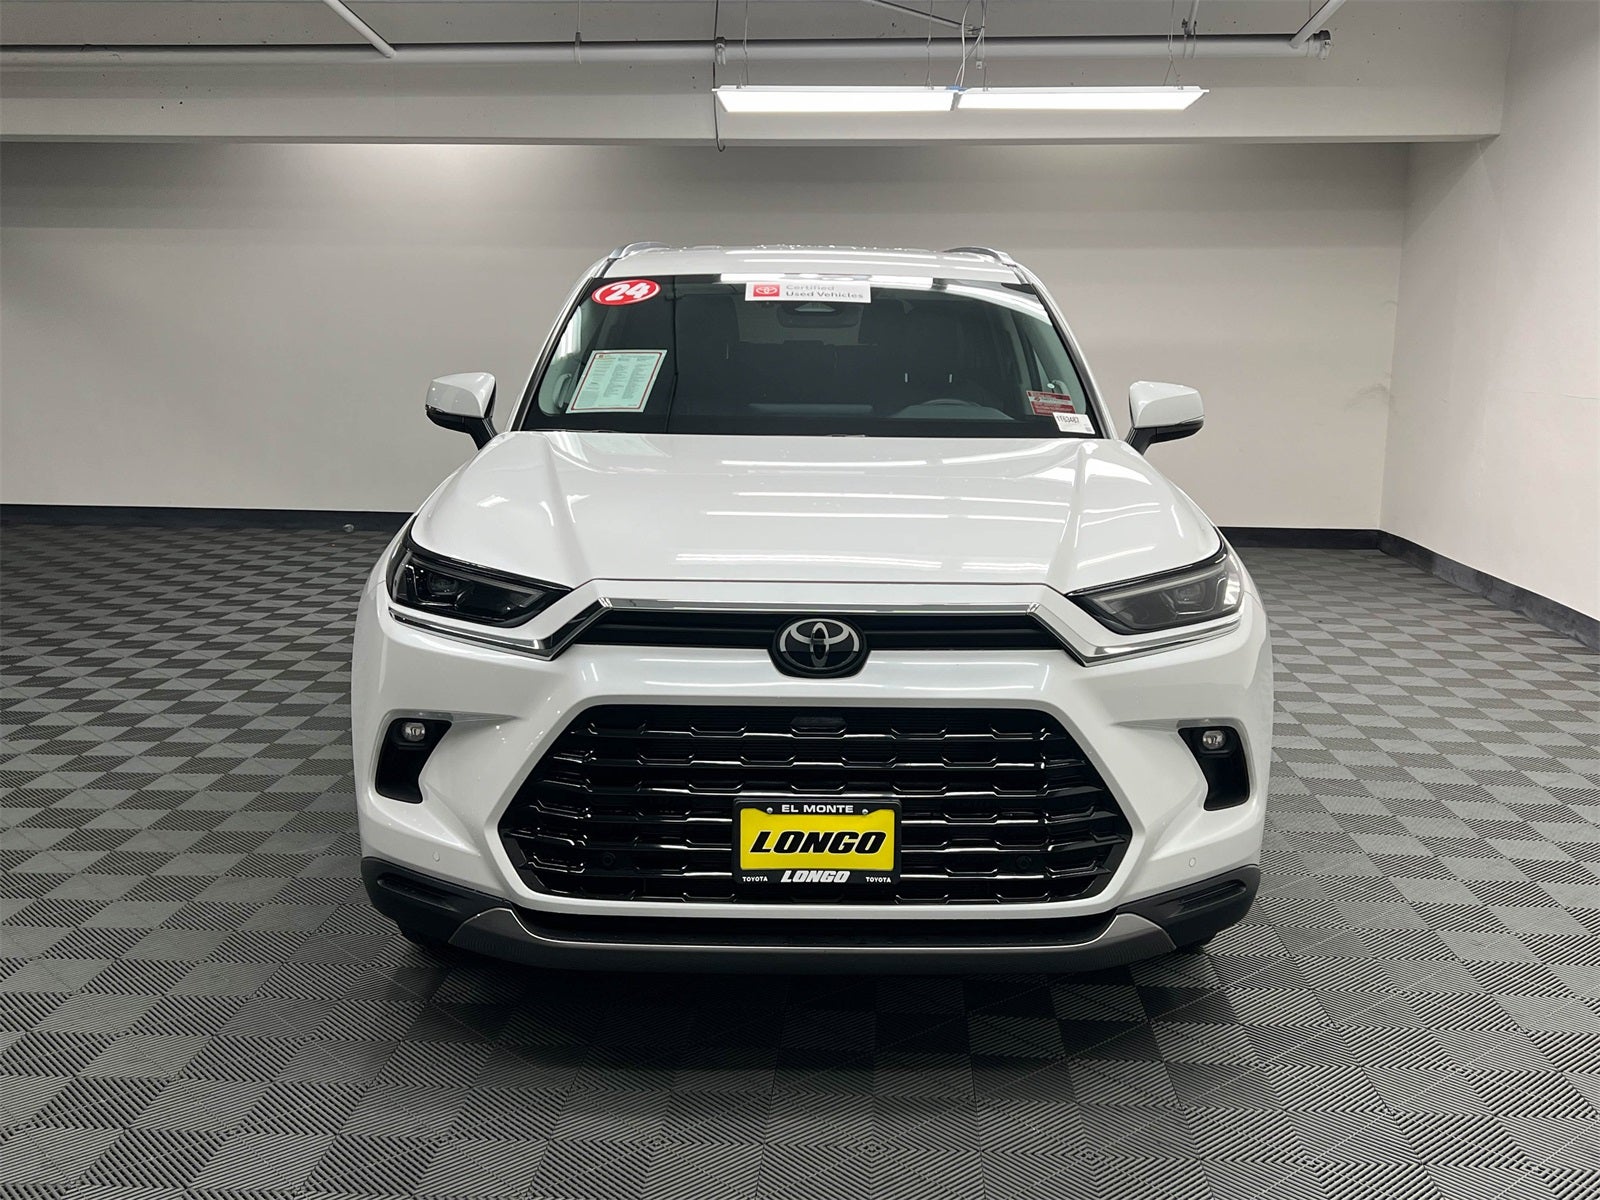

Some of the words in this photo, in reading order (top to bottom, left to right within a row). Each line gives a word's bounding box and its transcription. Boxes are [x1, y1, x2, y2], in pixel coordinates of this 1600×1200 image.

[605, 282, 651, 302] 24
[816, 291, 864, 299] Vehicles
[781, 804, 799, 813] EL
[803, 804, 854, 814] MONTE
[749, 830, 887, 854] LONGO
[780, 870, 851, 883] LONGO
